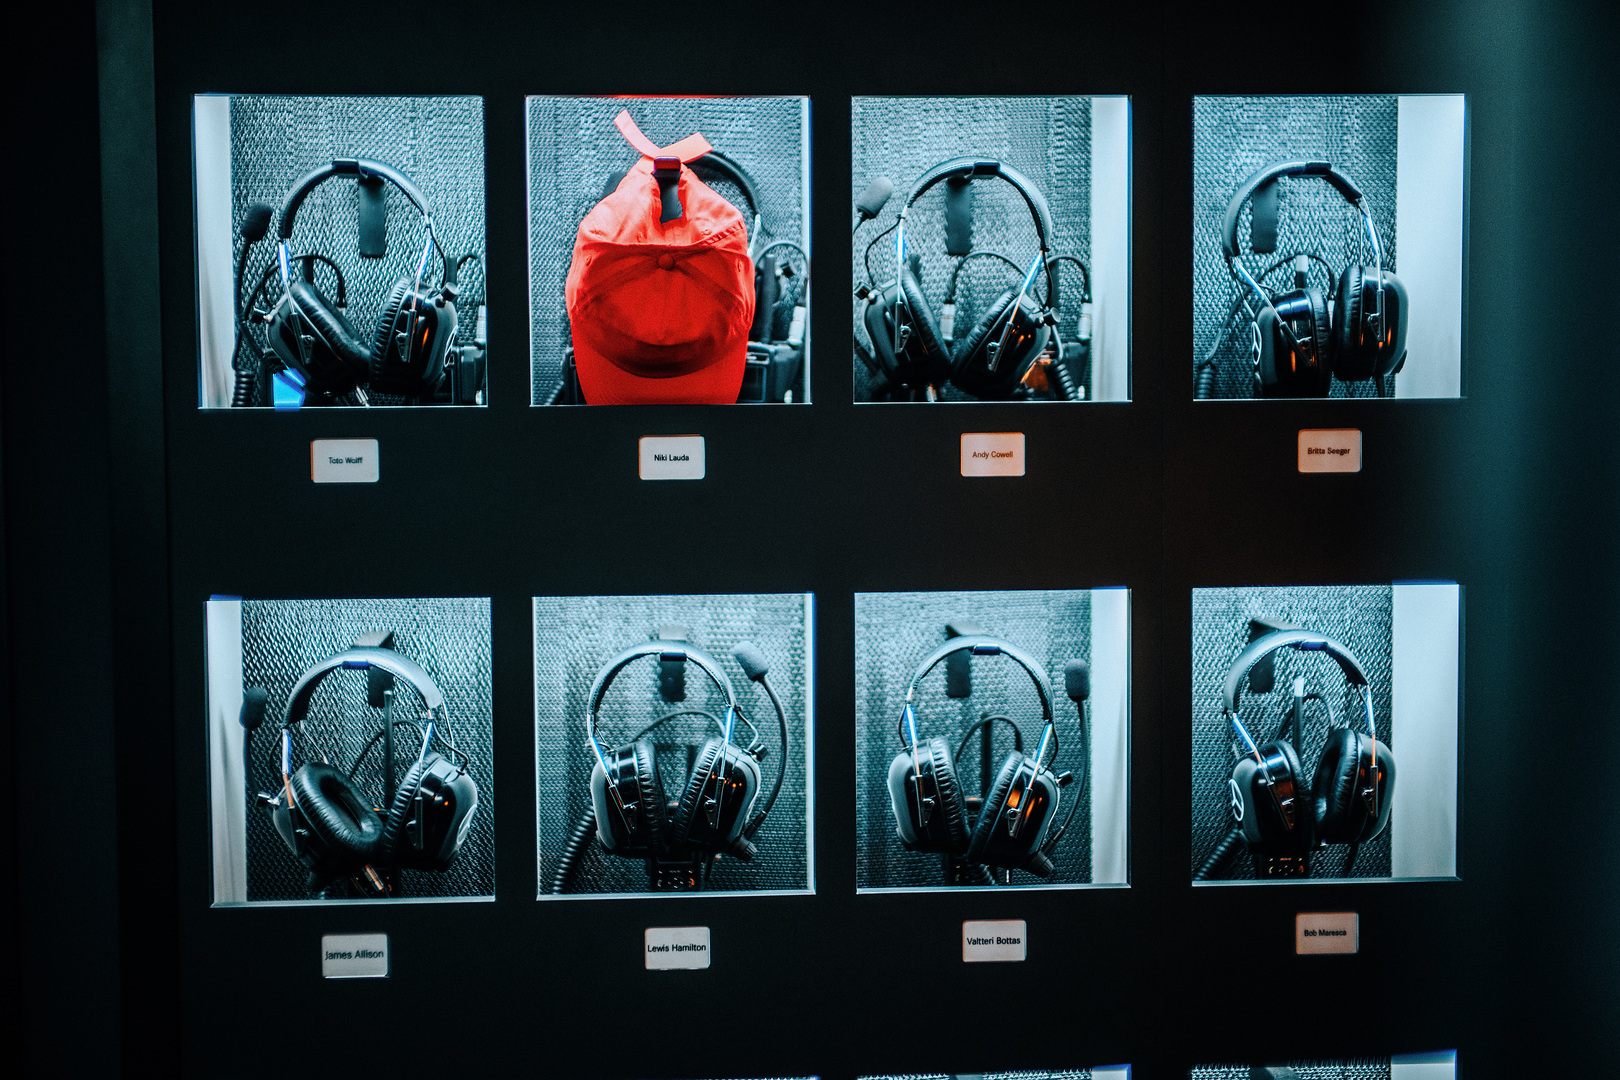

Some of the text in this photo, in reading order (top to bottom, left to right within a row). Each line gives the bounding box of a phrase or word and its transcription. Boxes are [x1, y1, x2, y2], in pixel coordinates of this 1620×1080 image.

[972, 451, 989, 459] Andy
[1327, 447, 1350, 456] Seeger
[1304, 929, 1317, 937] Bob
[967, 936, 1021, 945] Valtteri Bottas
[647, 943, 706, 952] Lewis Hamilton
[325, 950, 384, 960] James Allison
